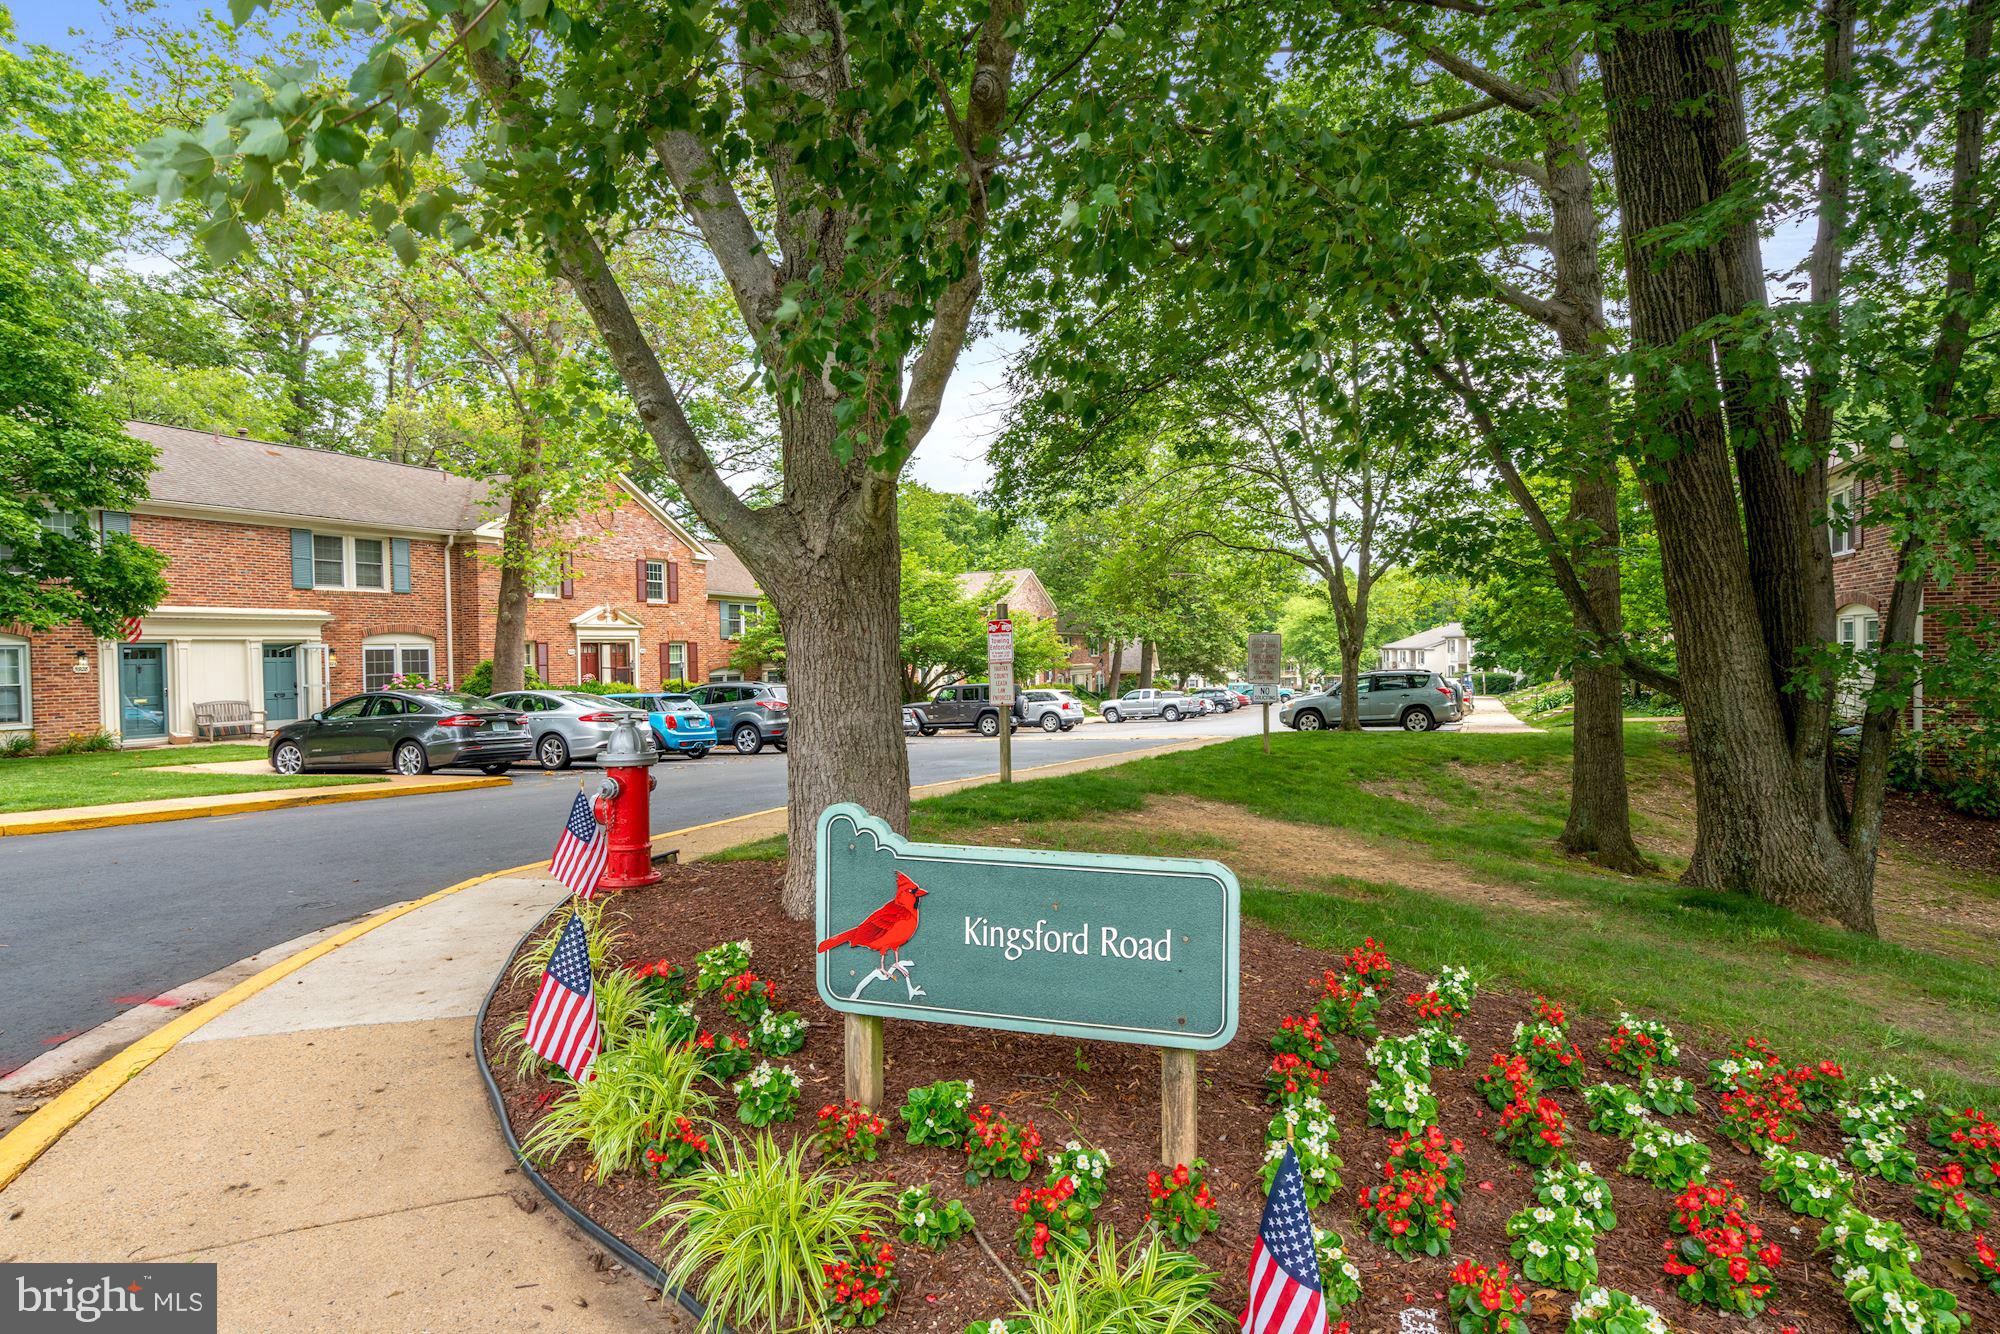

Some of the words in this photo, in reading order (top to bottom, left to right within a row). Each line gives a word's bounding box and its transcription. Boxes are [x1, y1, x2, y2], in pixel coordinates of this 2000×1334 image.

[1260, 687, 1270, 695] NO
[963, 915, 1089, 962] Kingsford
[1100, 926, 1172, 963] Road
